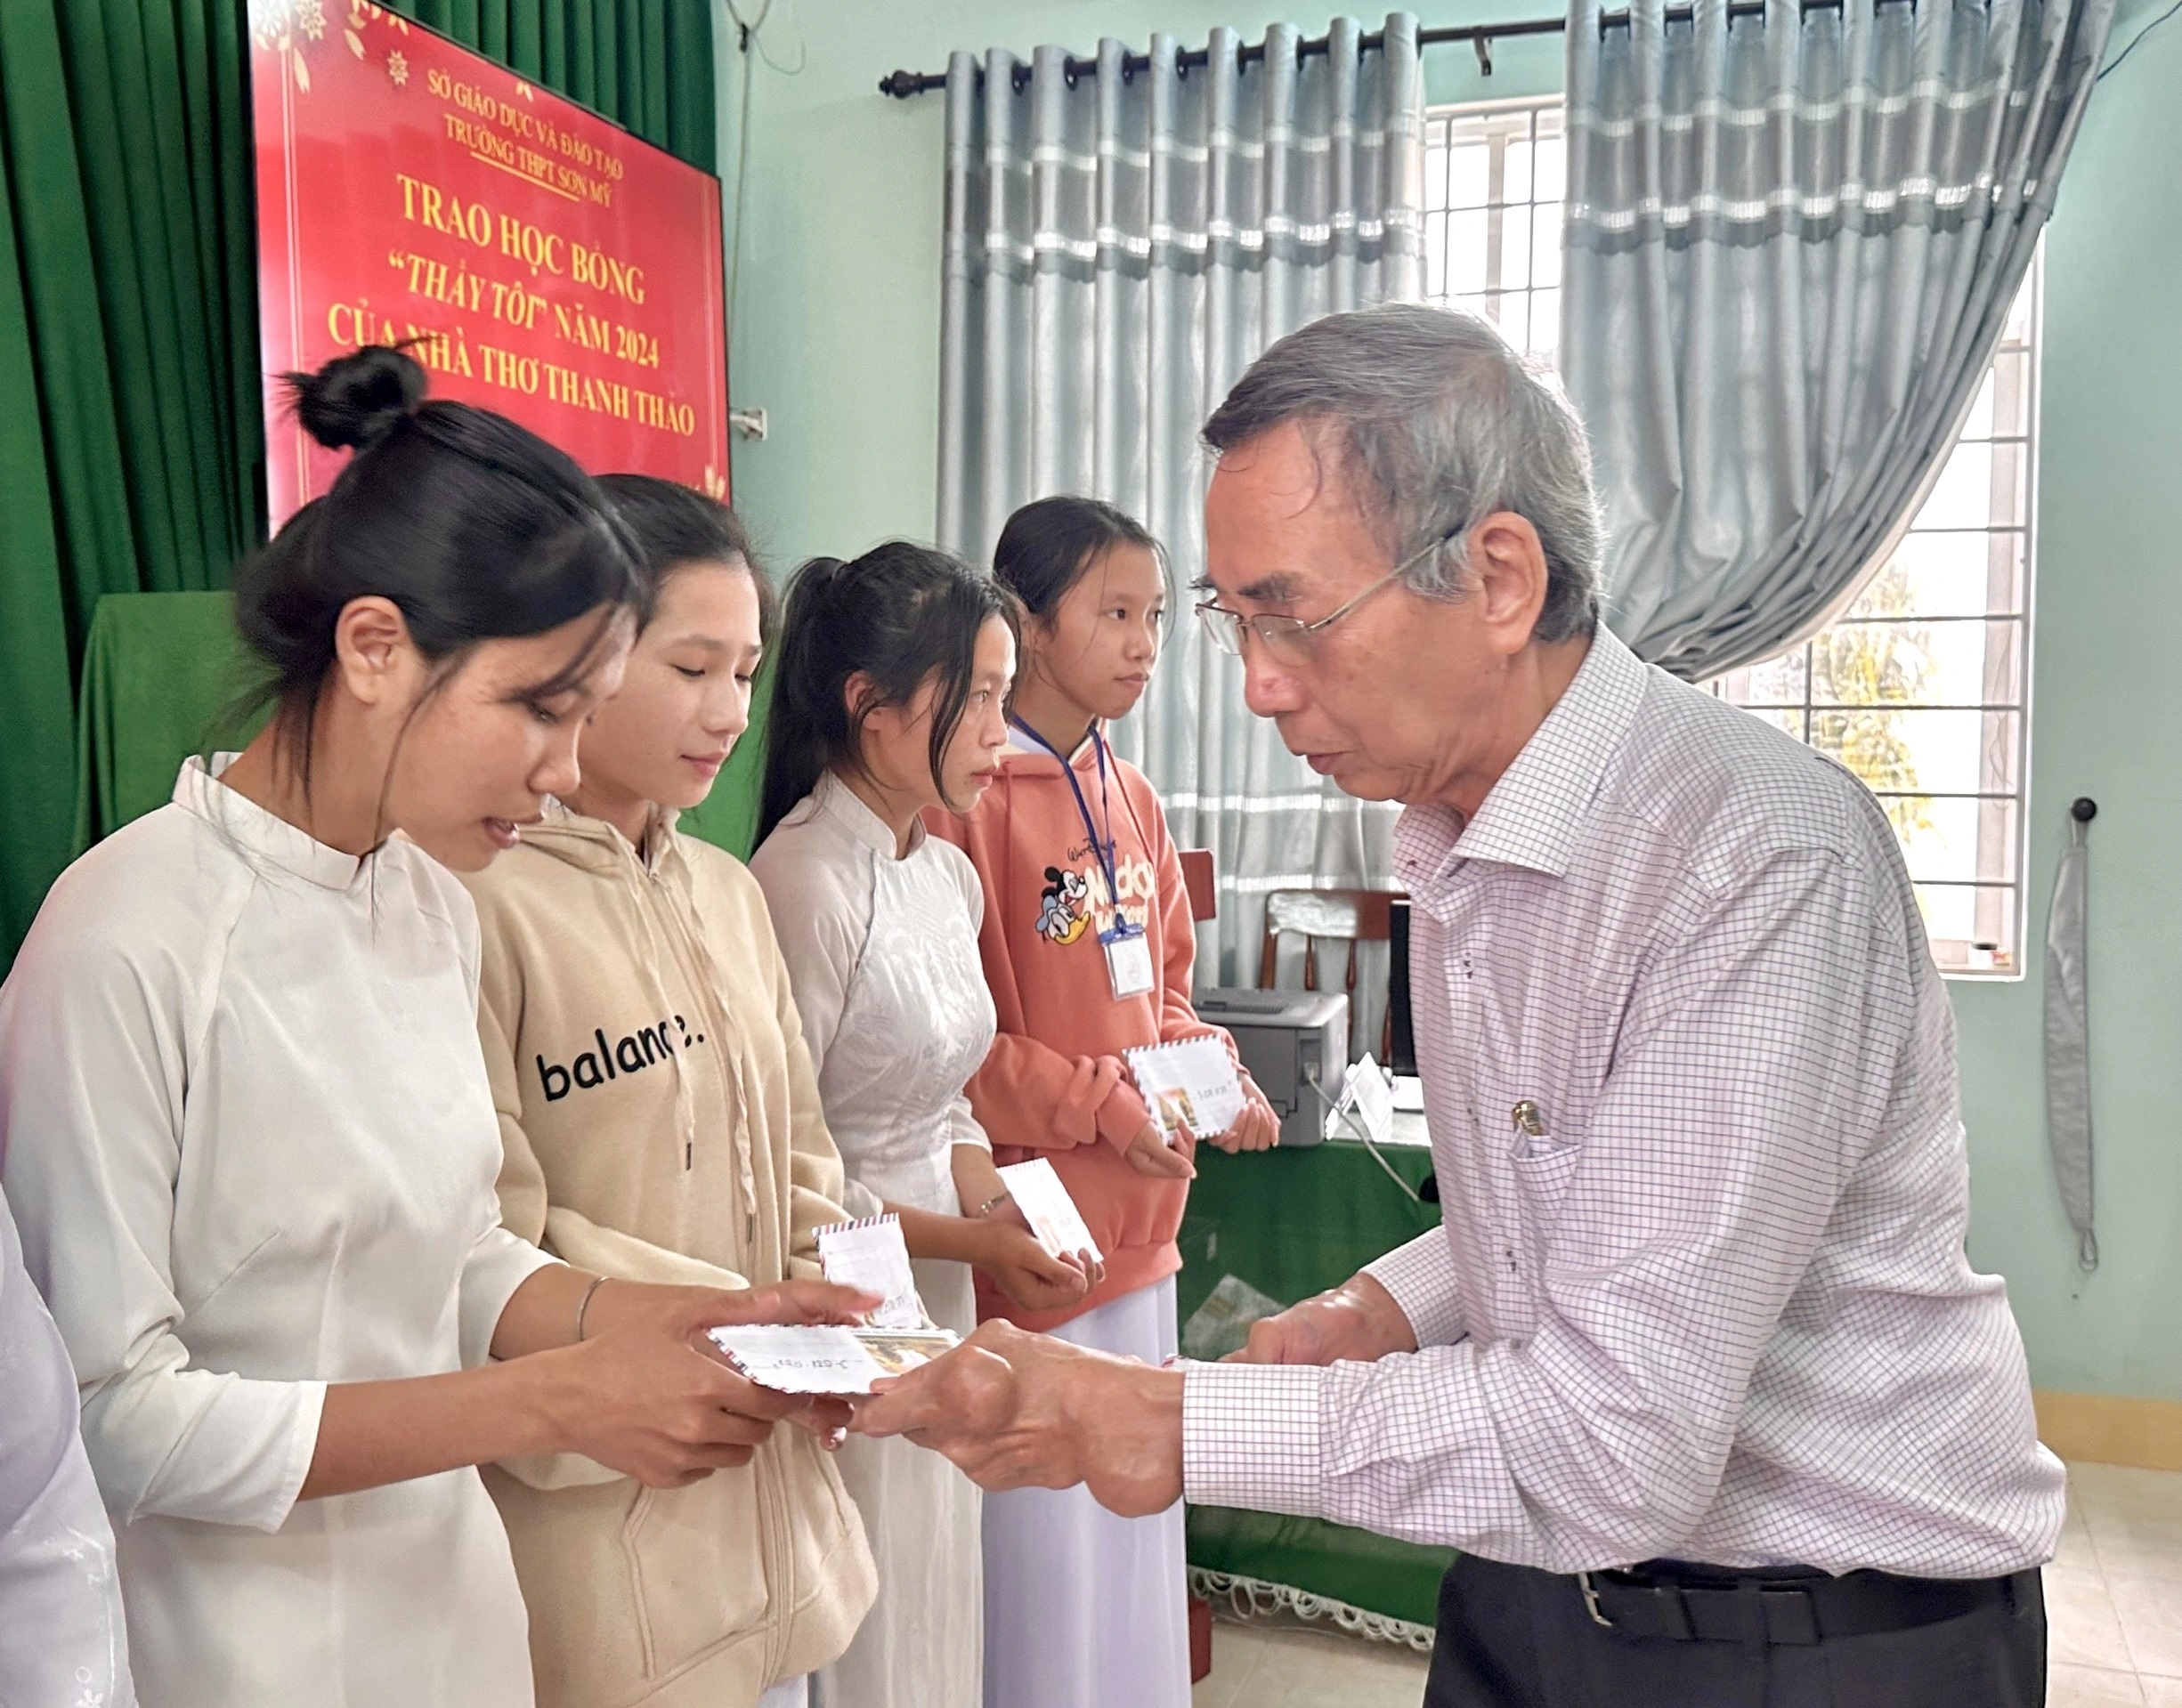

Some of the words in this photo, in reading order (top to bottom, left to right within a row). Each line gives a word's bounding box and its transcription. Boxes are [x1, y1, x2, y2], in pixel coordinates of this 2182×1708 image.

[444, 113, 515, 166] TRƯỜNG
[516, 146, 556, 182] THPT
[454, 83, 497, 120] GIÁO
[499, 102, 533, 138] DỤC
[536, 118, 558, 151] VÀ
[560, 132, 593, 166] ĐÀO
[595, 149, 623, 181] TẠO
[397, 174, 491, 247] TRAO
[499, 214, 564, 278] HỌC
[328, 296, 395, 348] CỦA
[407, 326, 474, 380] NHÀ
[478, 344, 539, 395] THƠ
[543, 362, 629, 420] THANH
[633, 390, 695, 436] THẢO
[554, 302, 610, 354] NĂM
[616, 325, 659, 369] 2024
